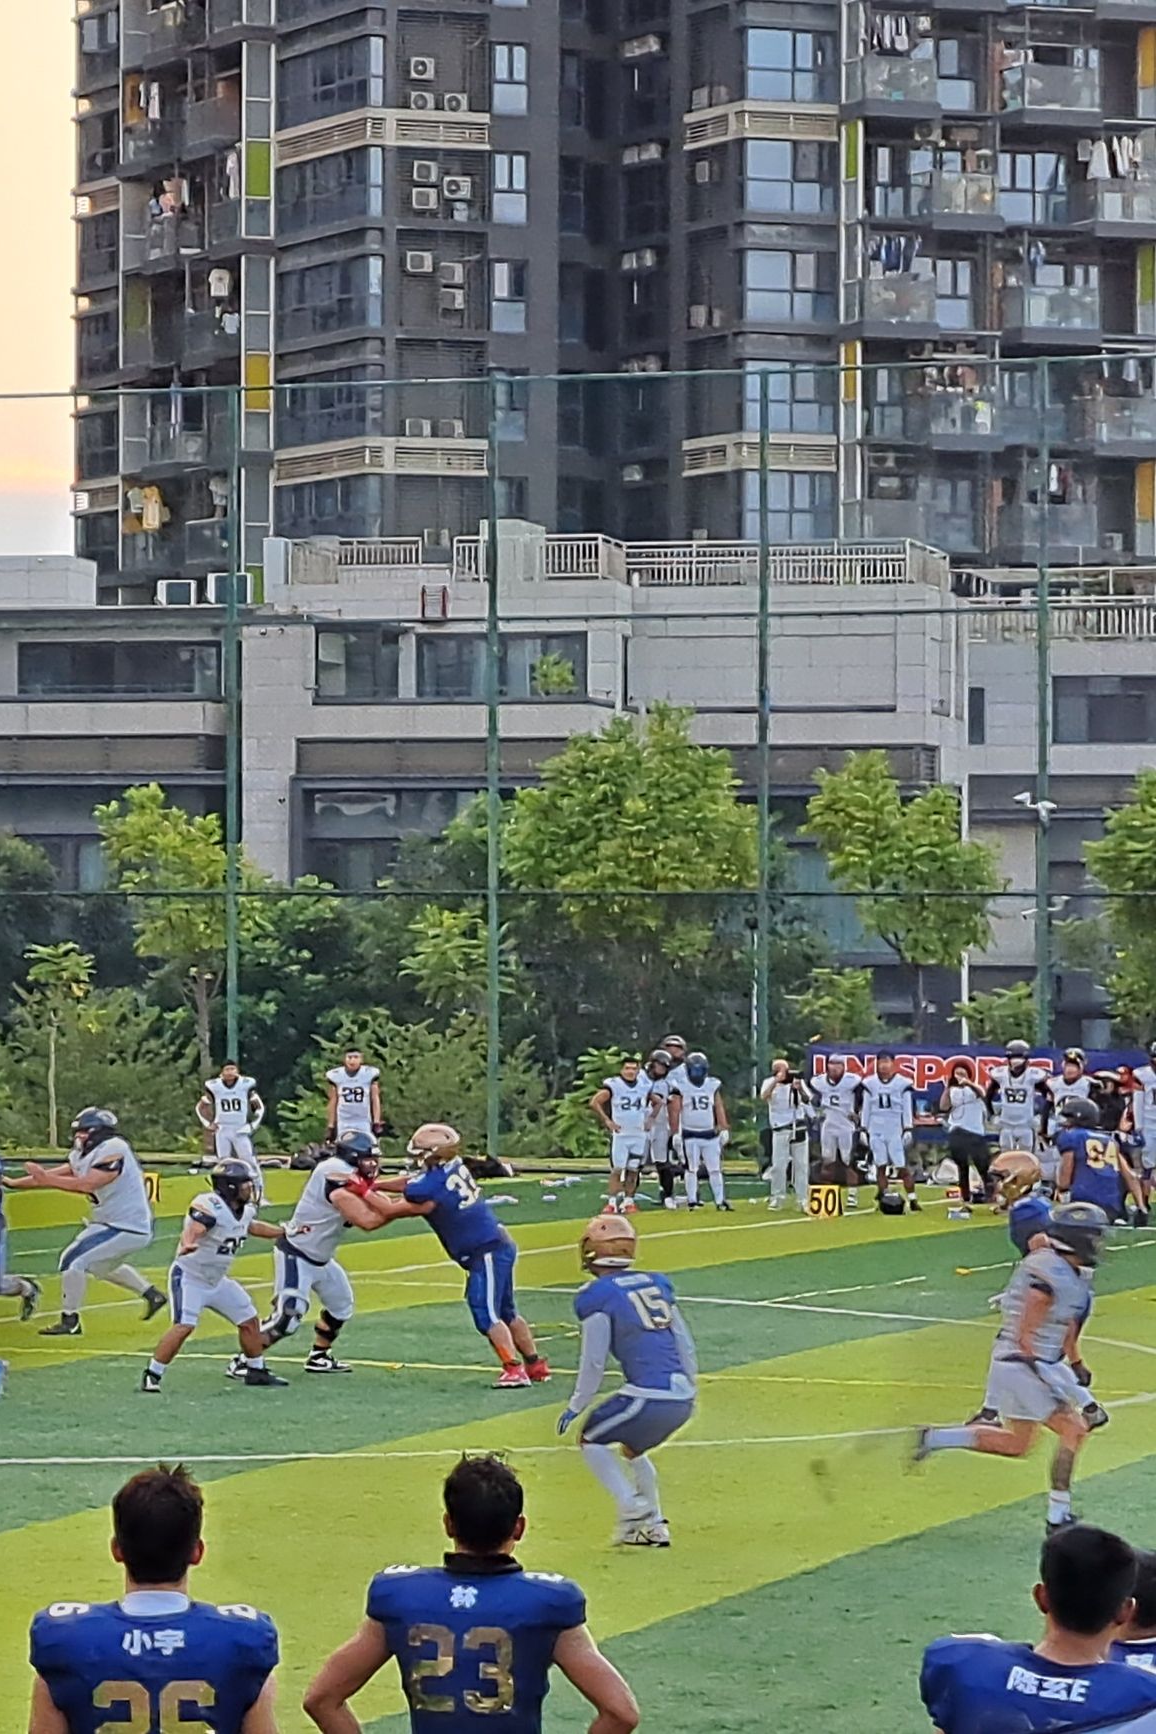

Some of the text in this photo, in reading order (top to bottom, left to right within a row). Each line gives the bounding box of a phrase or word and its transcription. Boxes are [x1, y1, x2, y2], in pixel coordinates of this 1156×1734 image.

[620, 1096, 642, 1111] 24
[809, 1188, 837, 1216] 50
[627, 1286, 672, 1329] 15
[408, 1622, 514, 1714] 23
